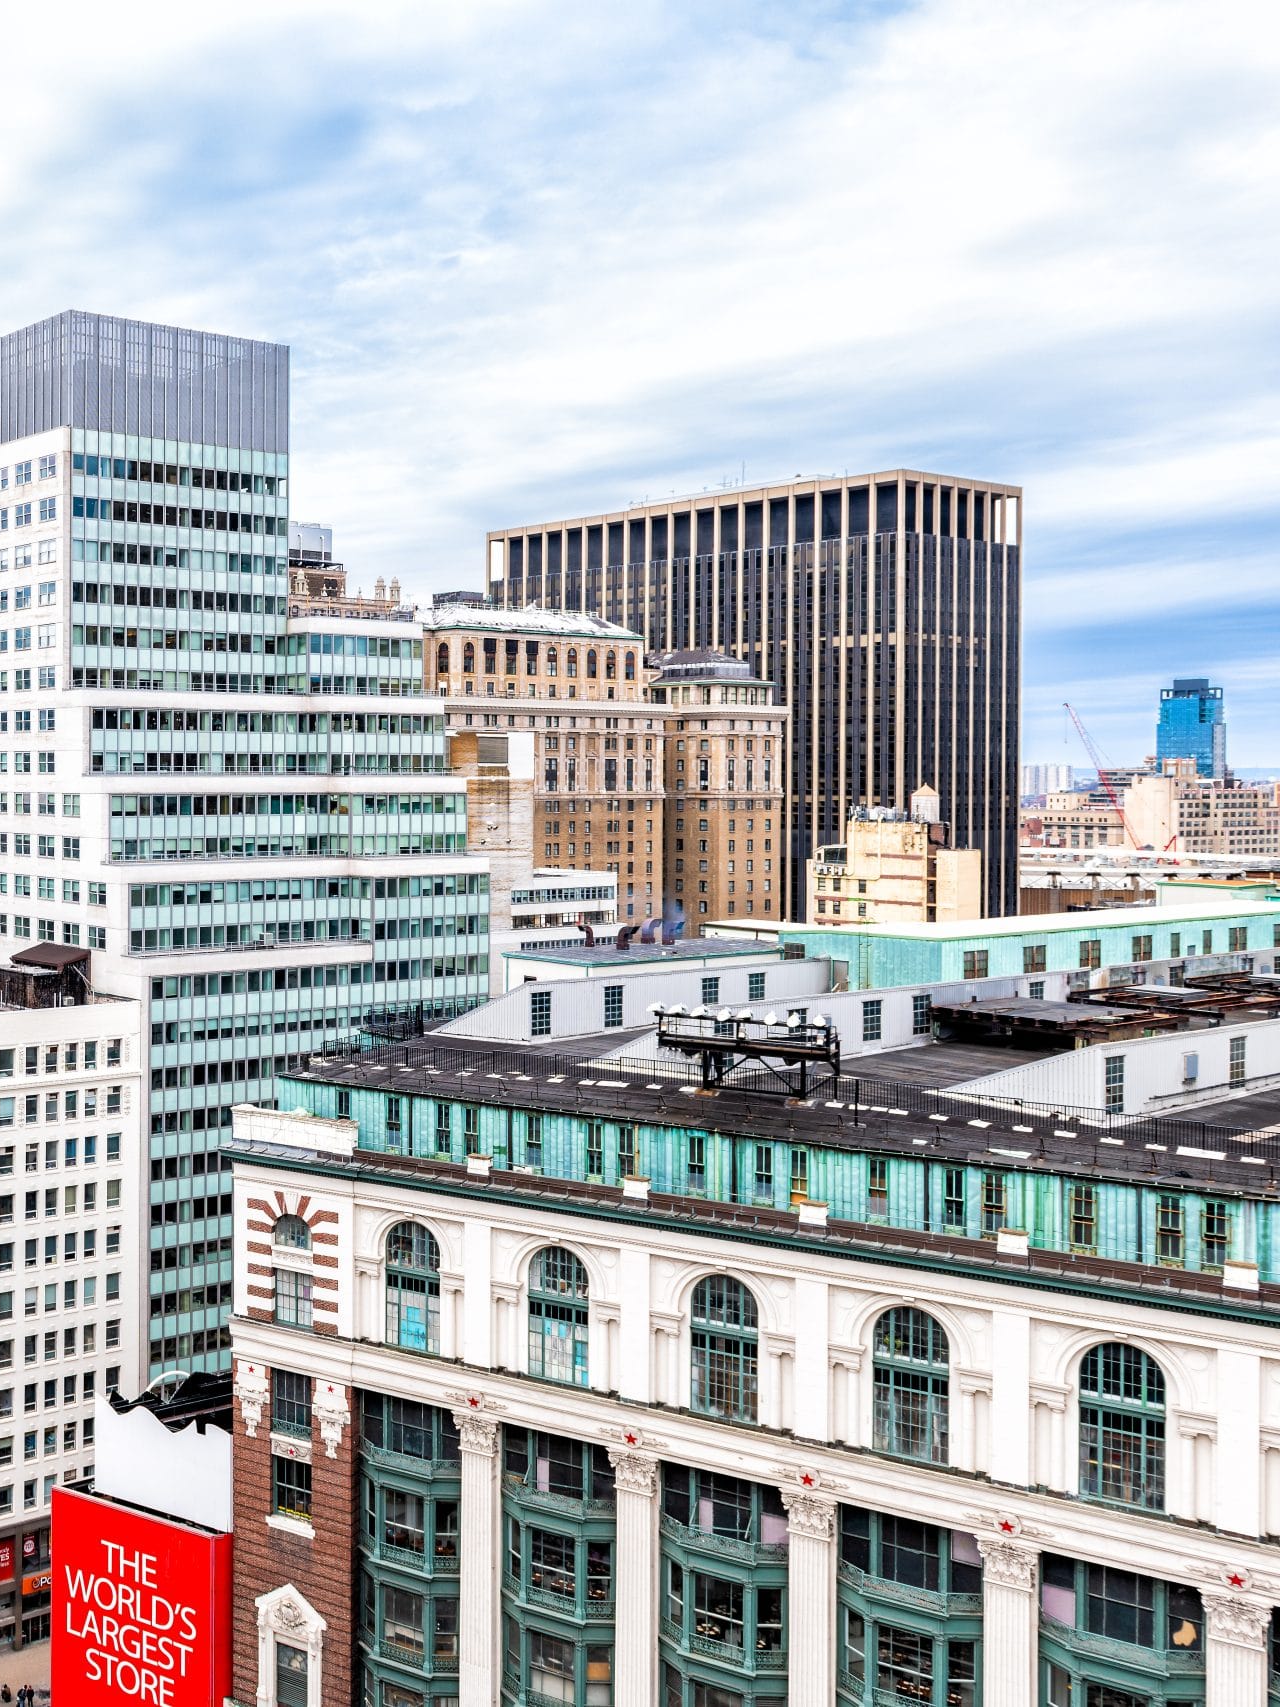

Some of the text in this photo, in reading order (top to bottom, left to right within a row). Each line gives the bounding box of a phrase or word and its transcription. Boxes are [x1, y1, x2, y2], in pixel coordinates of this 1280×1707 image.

[100, 1539, 158, 1589] THE
[65, 1564, 197, 1641] WORLD'S
[66, 1602, 194, 1677] LARGEST
[85, 1648, 175, 1707] STORE
